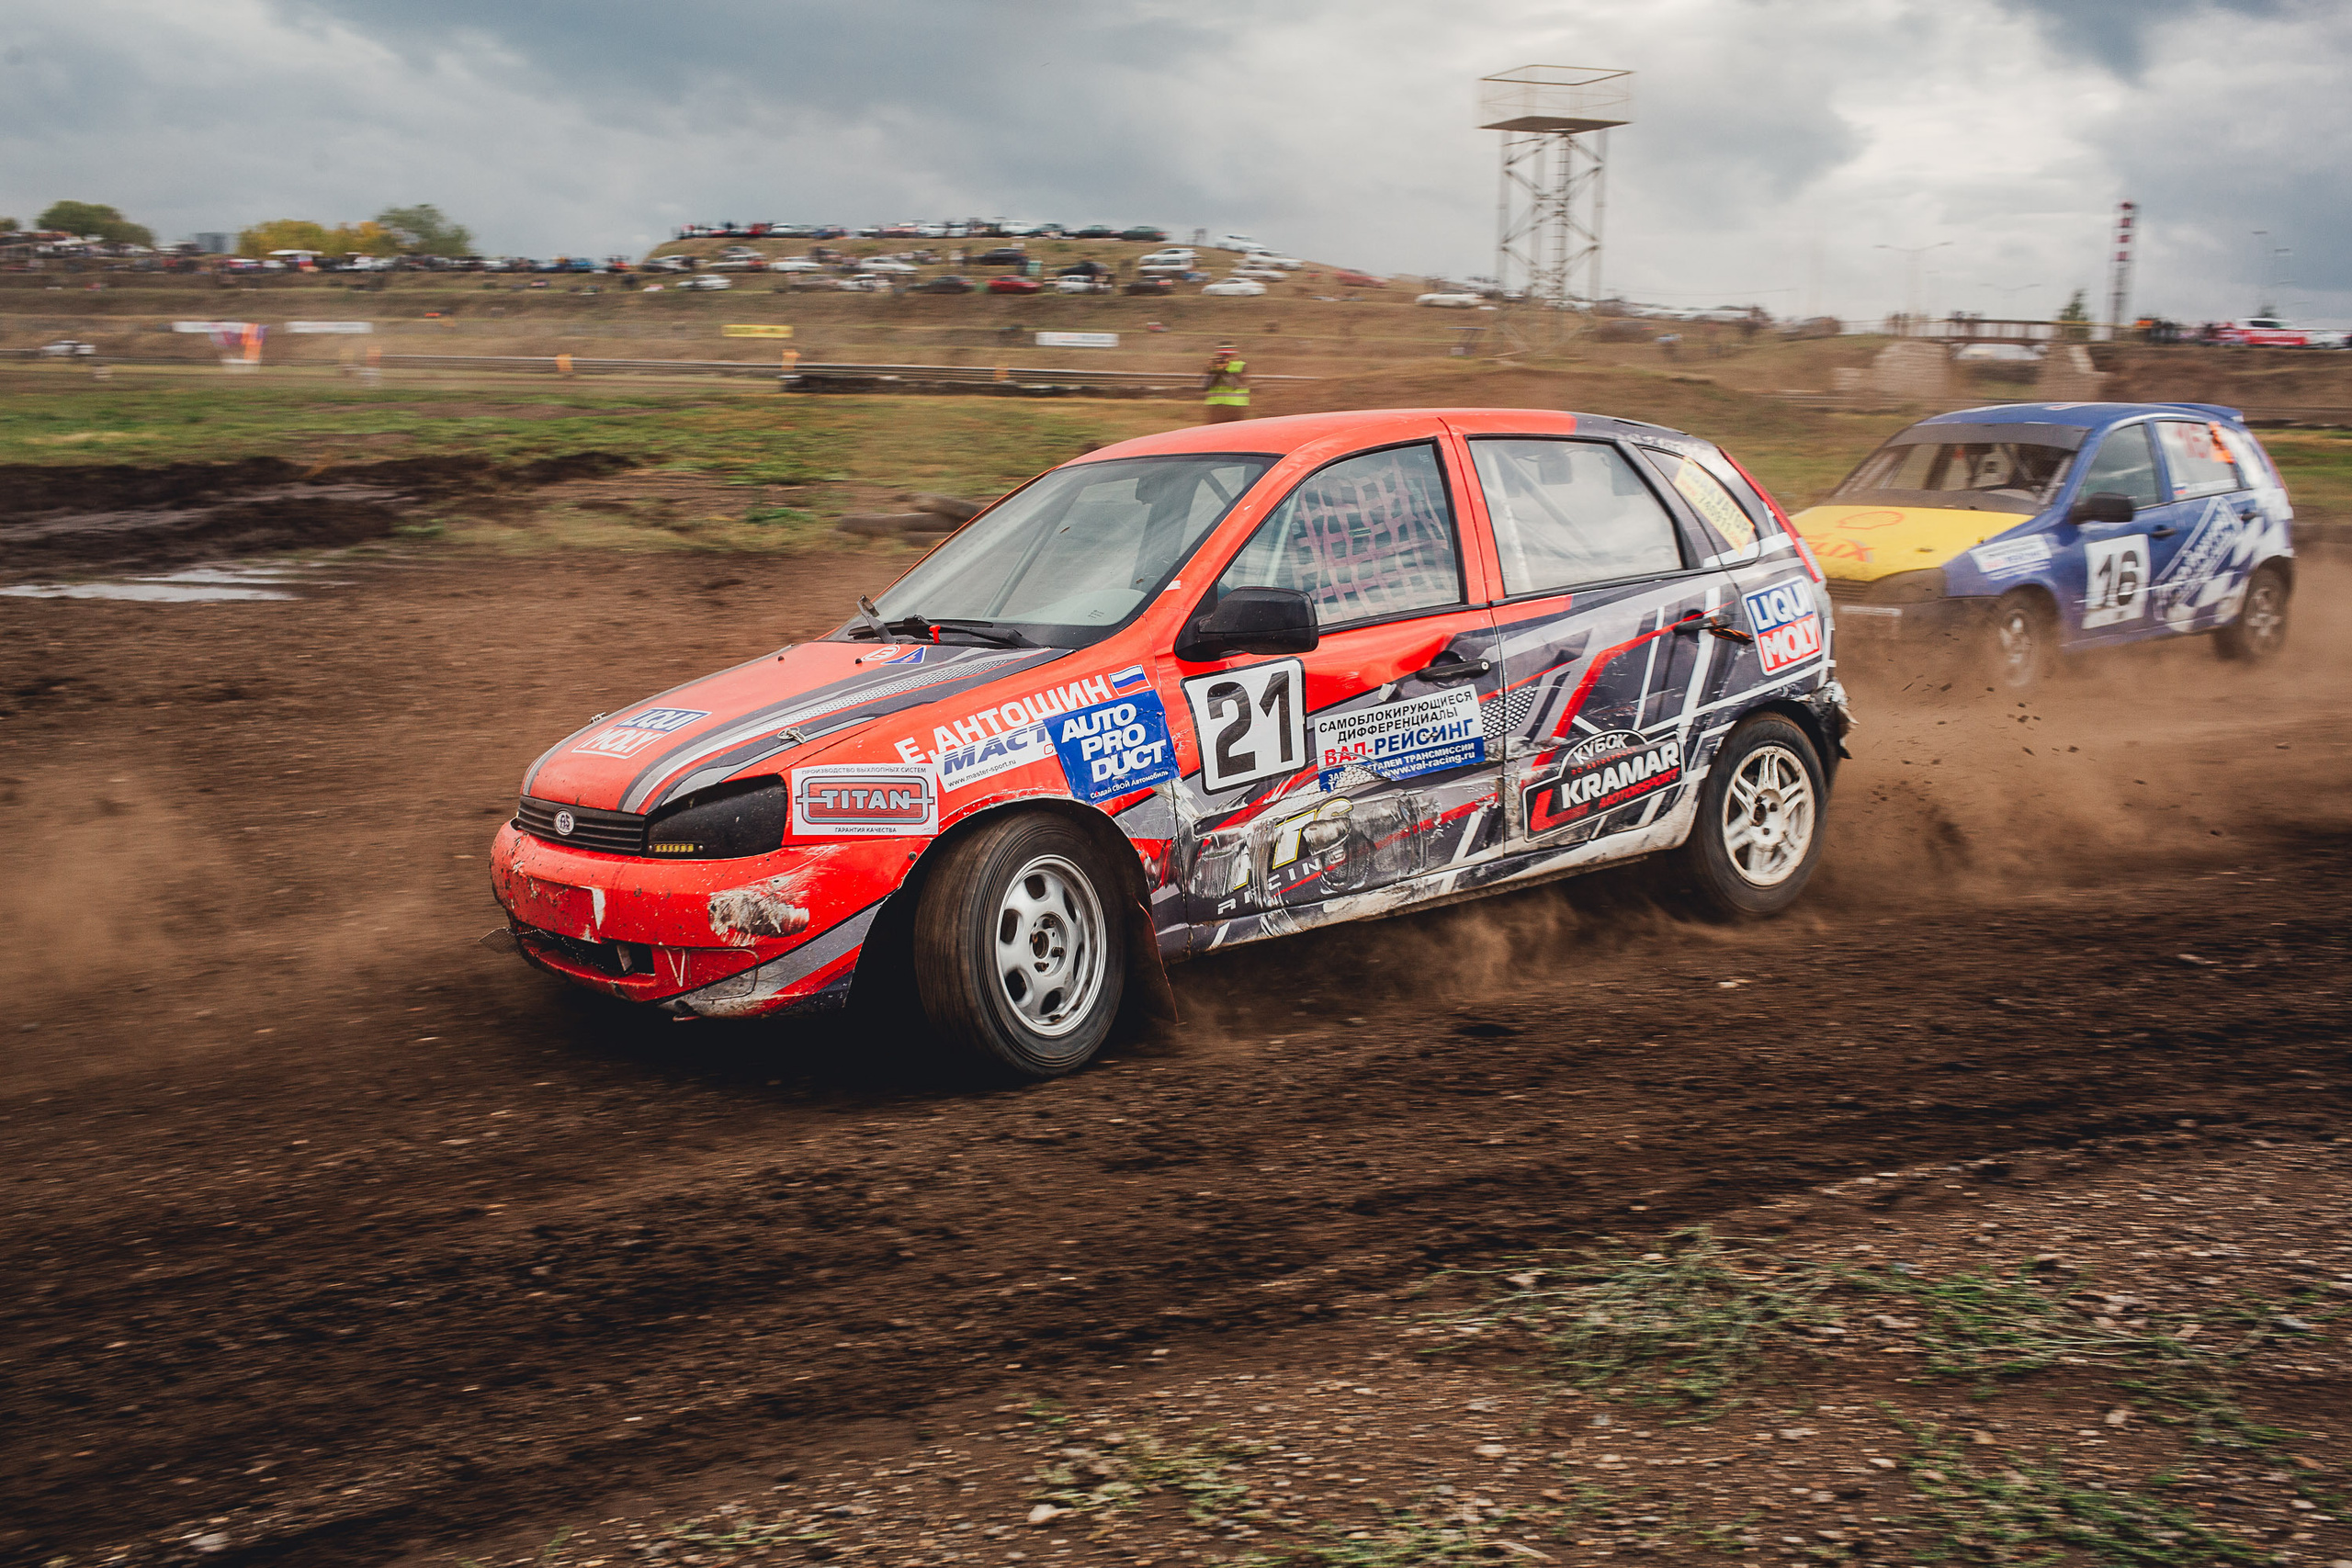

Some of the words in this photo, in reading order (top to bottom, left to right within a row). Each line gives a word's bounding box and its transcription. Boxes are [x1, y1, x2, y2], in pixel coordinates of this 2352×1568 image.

[2098, 550, 2139, 606] 16
[1759, 617, 1819, 668] MOLY
[617, 710, 703, 731] LIQUI
[894, 674, 1114, 764] Е.АНТОШИН
[1061, 703, 1136, 743] AUTO
[1207, 671, 1294, 779] 21
[1319, 692, 1473, 733] САМОБЛОКИРУЮЩИЕСЯ
[1338, 706, 1458, 744] ДИФФЕРЕНЦИАЛЫ
[581, 728, 664, 753] MOLY
[1080, 723, 1147, 761] PRO
[1324, 718, 1474, 768] ВАЛ-РЕЙСИНГ
[1403, 743, 1475, 764] ТРАНСМИССИИ
[1573, 734, 1630, 765] КУБОК
[802, 766, 855, 775] ПРОИЗВОДСТВО
[947, 759, 1017, 788] www.master-sport.ru
[1091, 739, 1167, 783] DUCT
[1381, 751, 1476, 779] www.val-racing.ru
[1561, 742, 1680, 809] KRAMAR
[820, 789, 910, 810] TITAN
